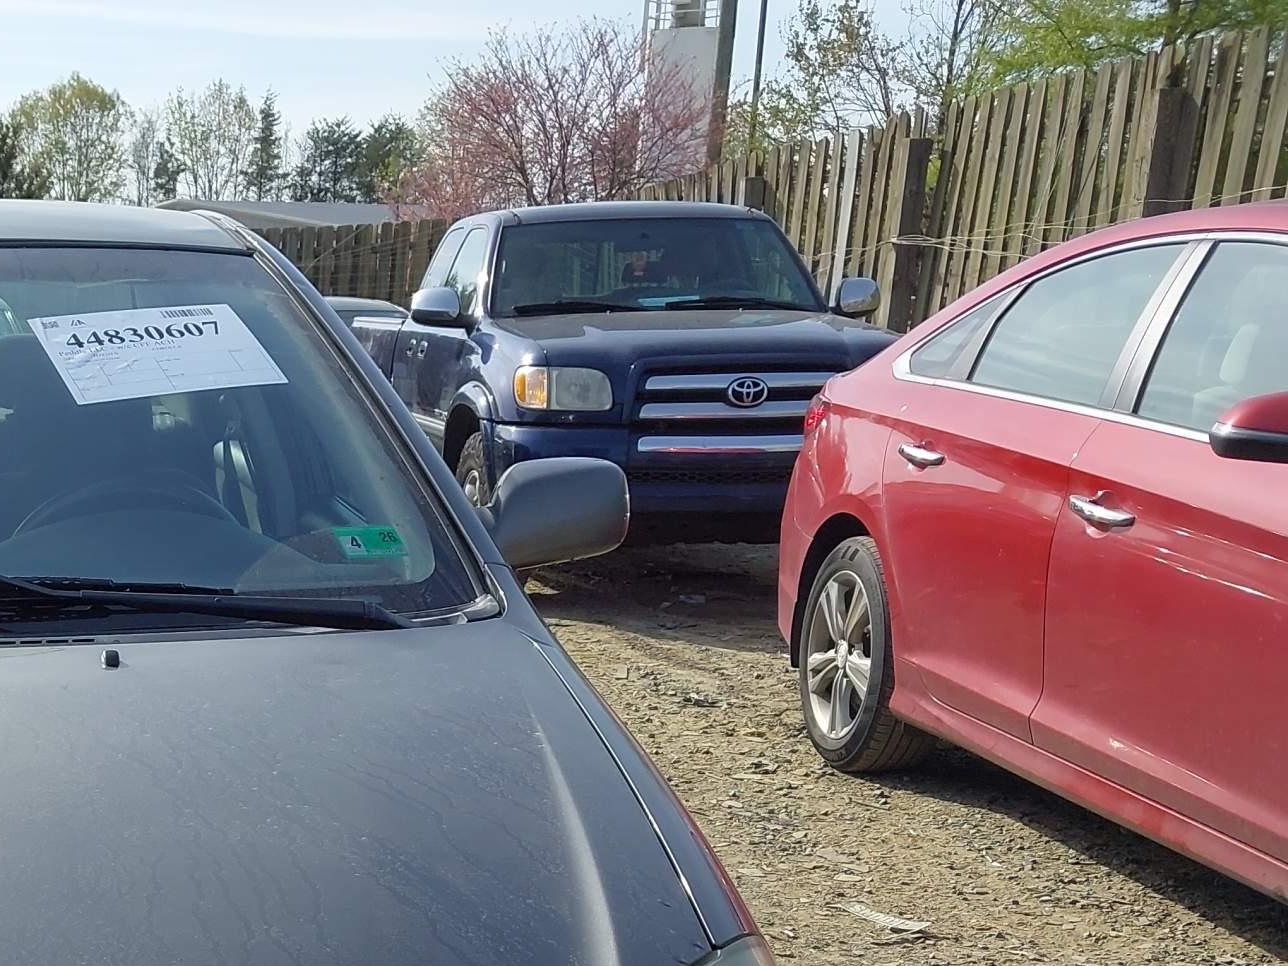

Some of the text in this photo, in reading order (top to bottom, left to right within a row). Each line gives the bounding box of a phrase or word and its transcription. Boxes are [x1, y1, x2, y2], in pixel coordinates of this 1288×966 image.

[65, 320, 220, 349] 44830607
[350, 535, 362, 549] 4
[378, 531, 398, 543] 26
